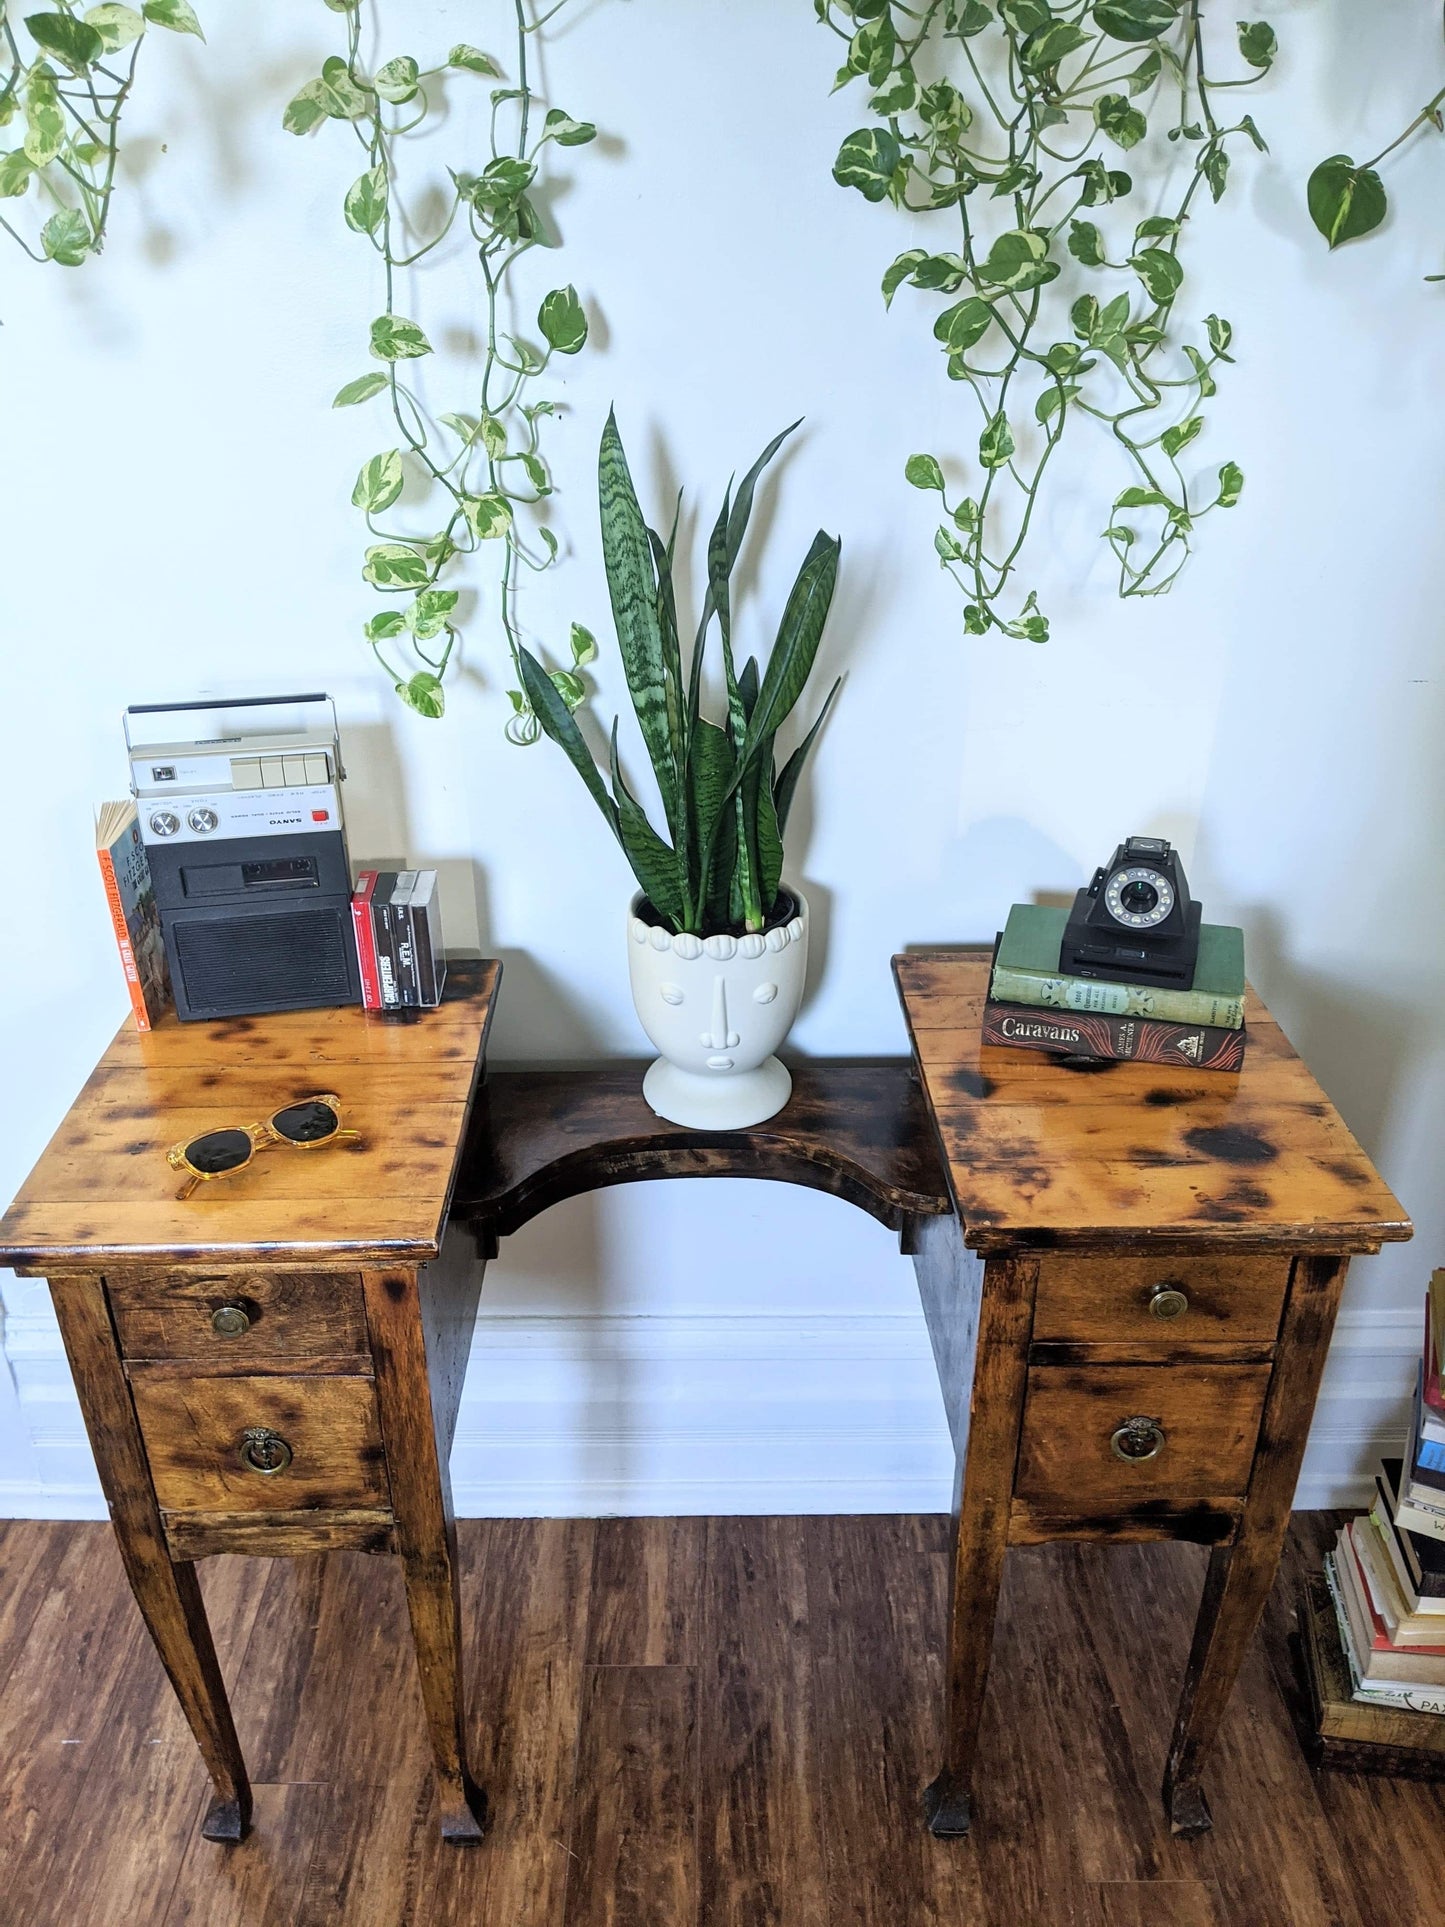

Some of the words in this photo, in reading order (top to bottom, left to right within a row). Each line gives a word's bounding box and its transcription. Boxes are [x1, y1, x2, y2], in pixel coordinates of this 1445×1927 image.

[131, 841, 144, 862] SCO
[103, 865, 117, 891] SCOTT
[110, 892, 128, 938] FITZGERALD
[121, 948, 133, 965] GREAT
[400, 942, 411, 968] R.E.M.
[379, 955, 396, 1003] CARPENTERS
[1001, 1017, 1081, 1043] Caravans
[1120, 1023, 1127, 1032] A.
[1124, 1022, 1135, 1057] MICHENER
[1117, 1033, 1126, 1055] JAMES
